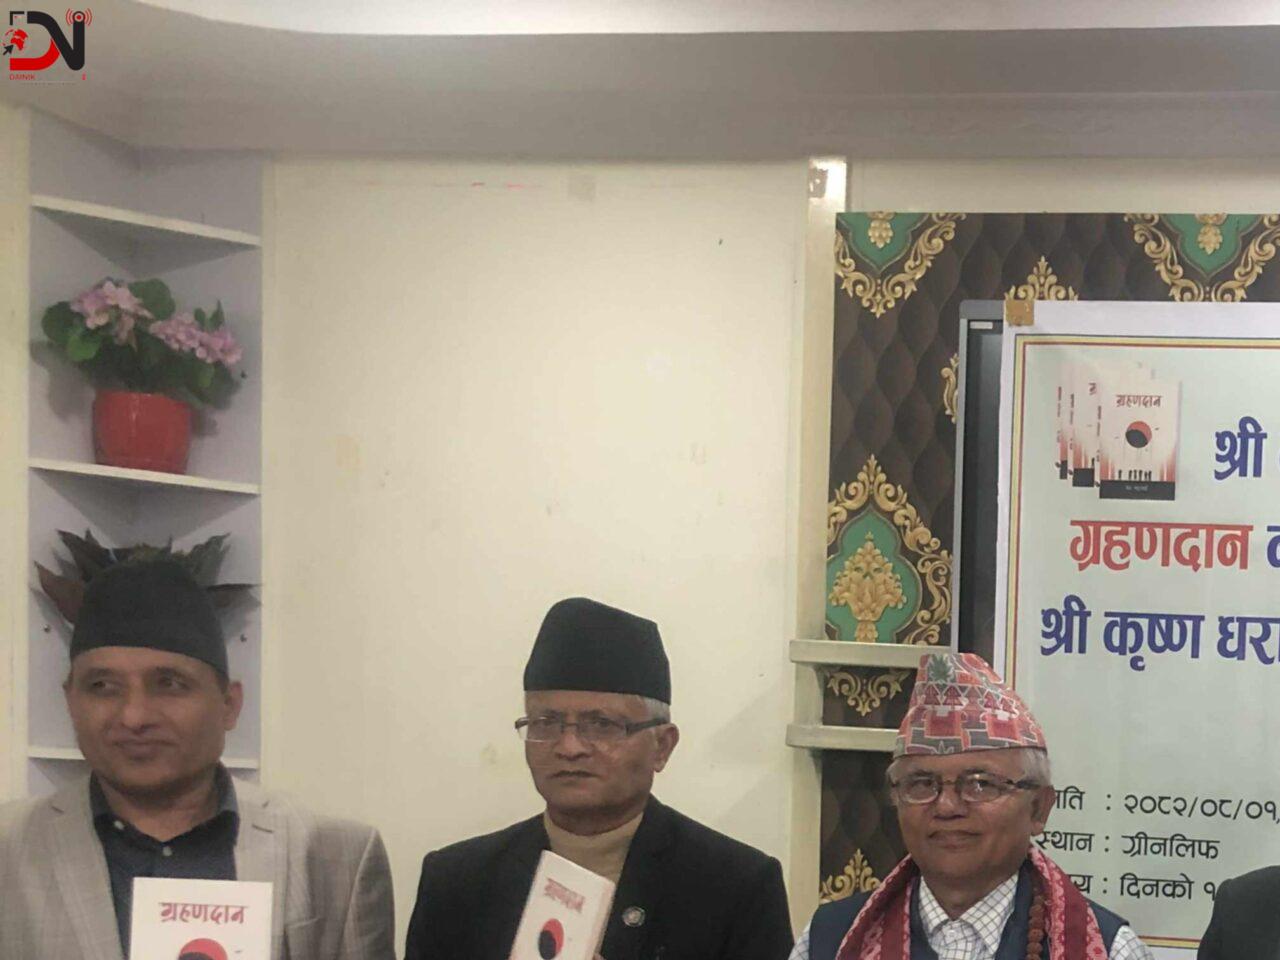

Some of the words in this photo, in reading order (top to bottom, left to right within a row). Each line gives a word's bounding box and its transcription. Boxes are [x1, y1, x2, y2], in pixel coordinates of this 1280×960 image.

[1116, 394, 1162, 408] ग्रहणदान
[1214, 416, 1267, 481] श्री
[1070, 520, 1254, 573] ग्रहणदान
[1041, 594, 1092, 656] श्री
[1103, 611, 1206, 672] कृष्ण
[1036, 831, 1095, 852] स्थान
[1121, 831, 1221, 860] ग्रीनलिफ
[1120, 872, 1195, 900] दिनको
[158, 902, 250, 924] ग्रहणदान
